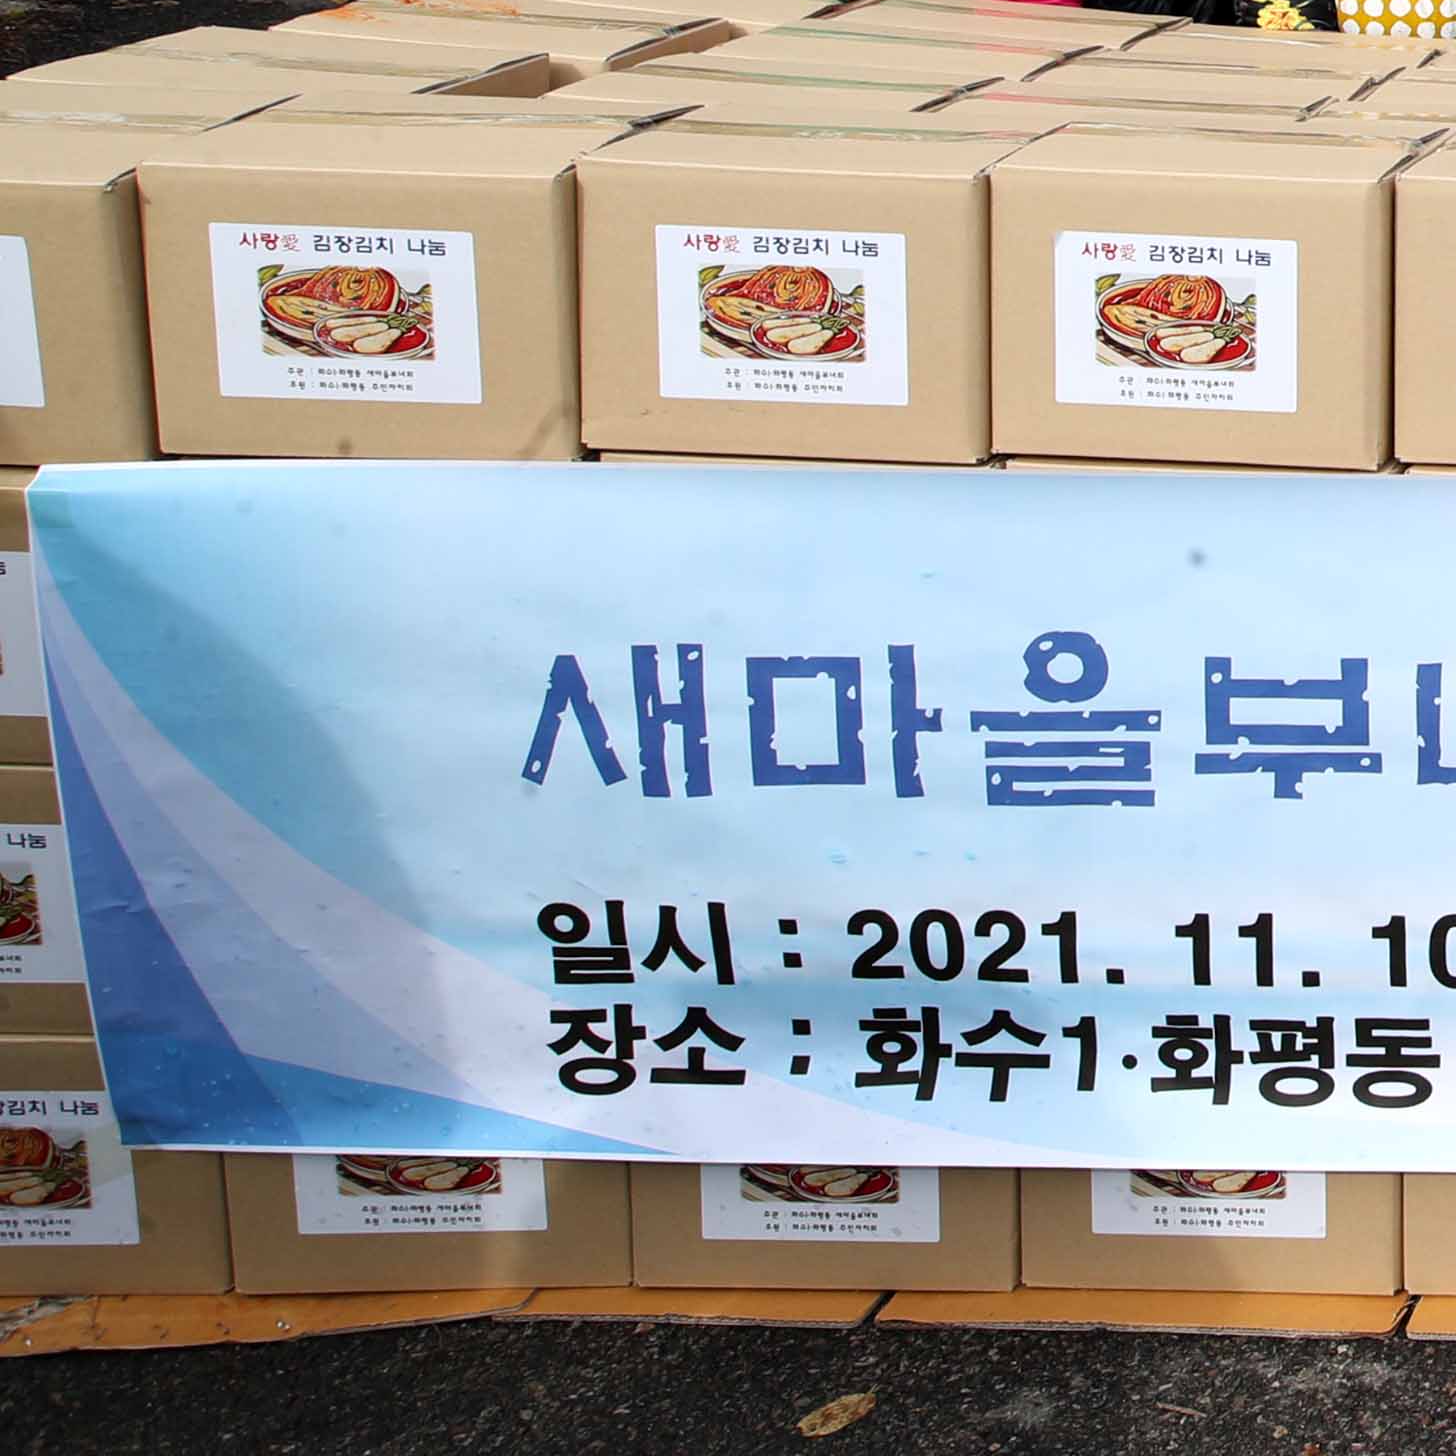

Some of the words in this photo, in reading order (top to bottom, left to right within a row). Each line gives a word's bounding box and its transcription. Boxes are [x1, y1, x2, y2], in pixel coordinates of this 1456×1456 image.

[314, 235, 393, 254] 김장김치
[408, 239, 445, 256] 나눔
[754, 236, 828, 255] 김장김치
[843, 240, 878, 257] 나눔
[1150, 245, 1222, 264] 김장김치
[1236, 249, 1271, 266] 나눔
[8, 833, 47, 849] 나눔
[537, 900, 735, 985] 일시
[847, 909, 1124, 984] 2021.
[1175, 913, 1320, 987] 11.
[548, 1004, 746, 1095] 장소
[855, 1006, 1440, 1106] 화수1·화평동
[0, 1100, 47, 1116] 김치
[60, 1100, 99, 1116] 나눔
